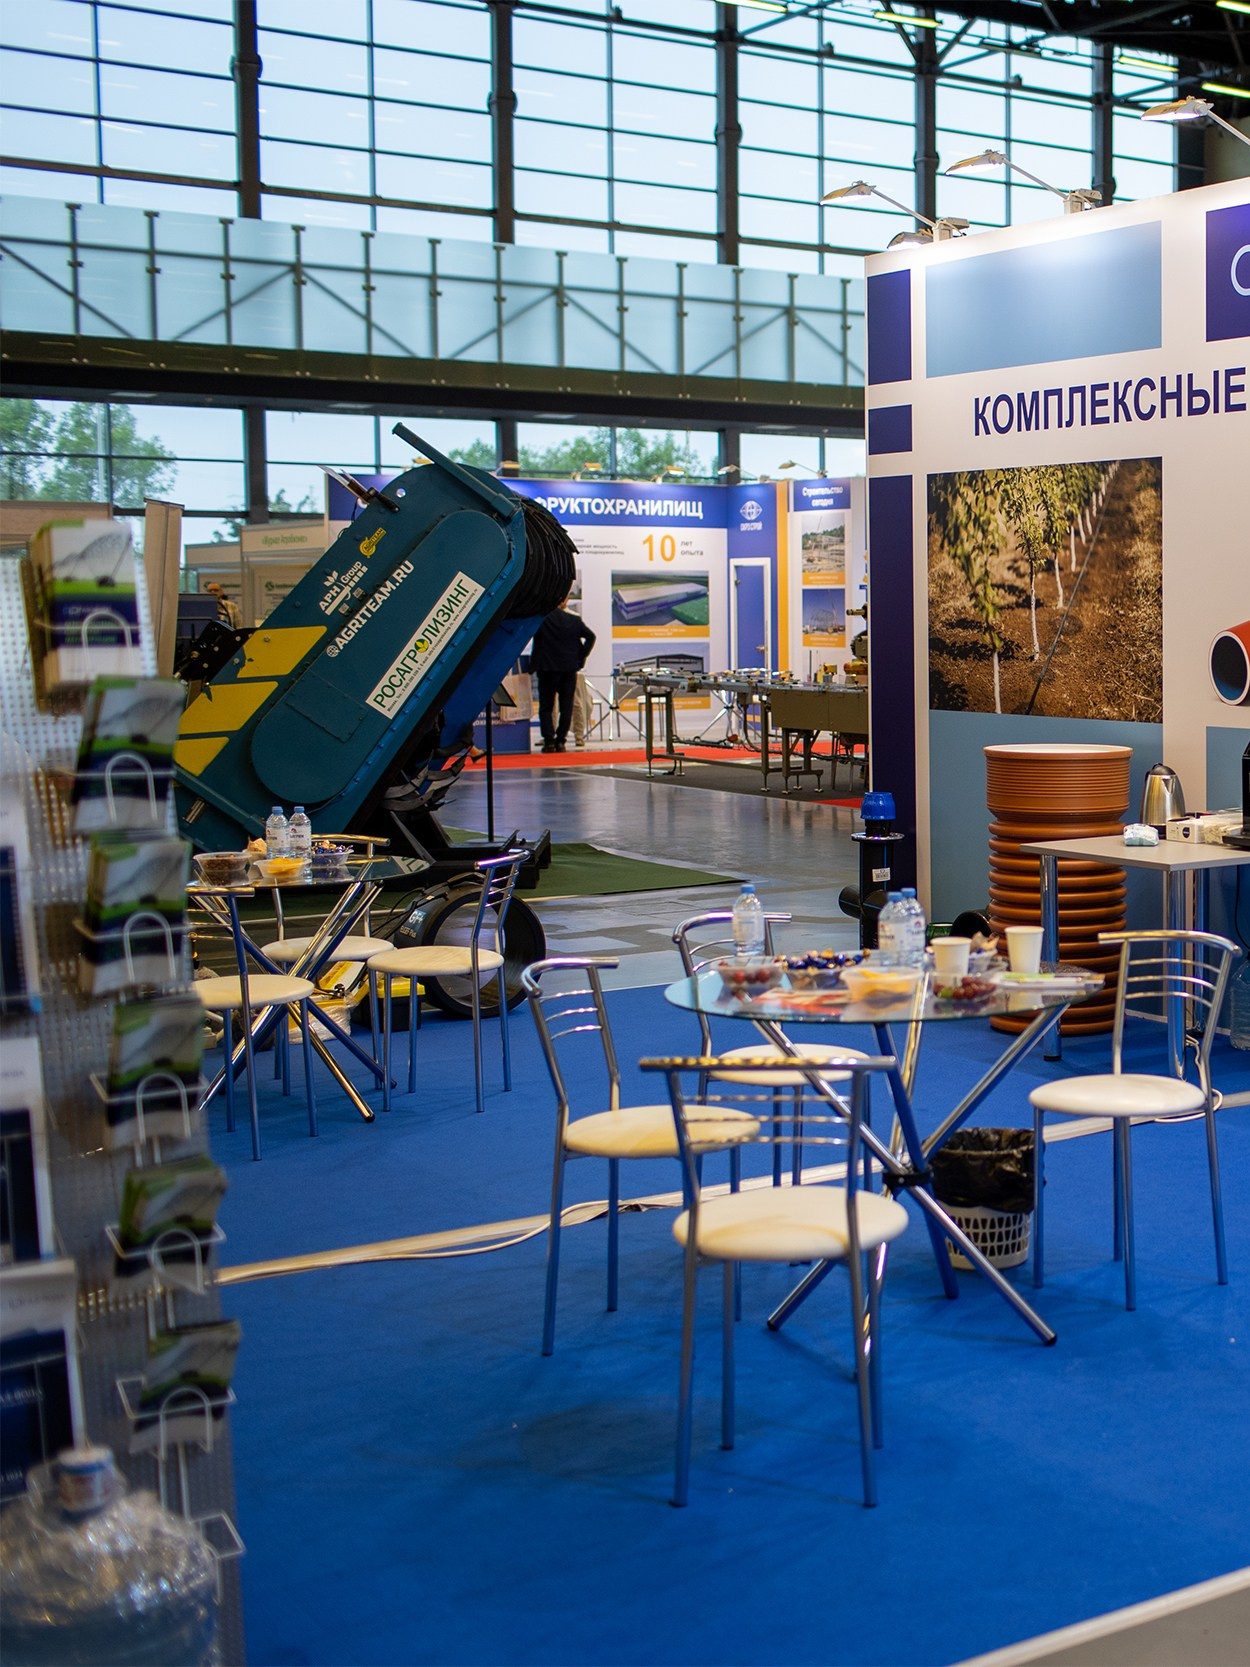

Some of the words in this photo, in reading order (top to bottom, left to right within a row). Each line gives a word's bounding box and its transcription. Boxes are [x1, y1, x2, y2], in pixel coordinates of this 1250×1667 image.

[974, 367, 1247, 437] КОМПЛЕКСНЫЕ
[340, 560, 363, 585] Group
[642, 534, 676, 562] 10
[680, 549, 704, 557] опыта
[334, 559, 415, 654] AGRITEAM.RU
[372, 578, 470, 709] РОСАГРОЛИЗИНГ
